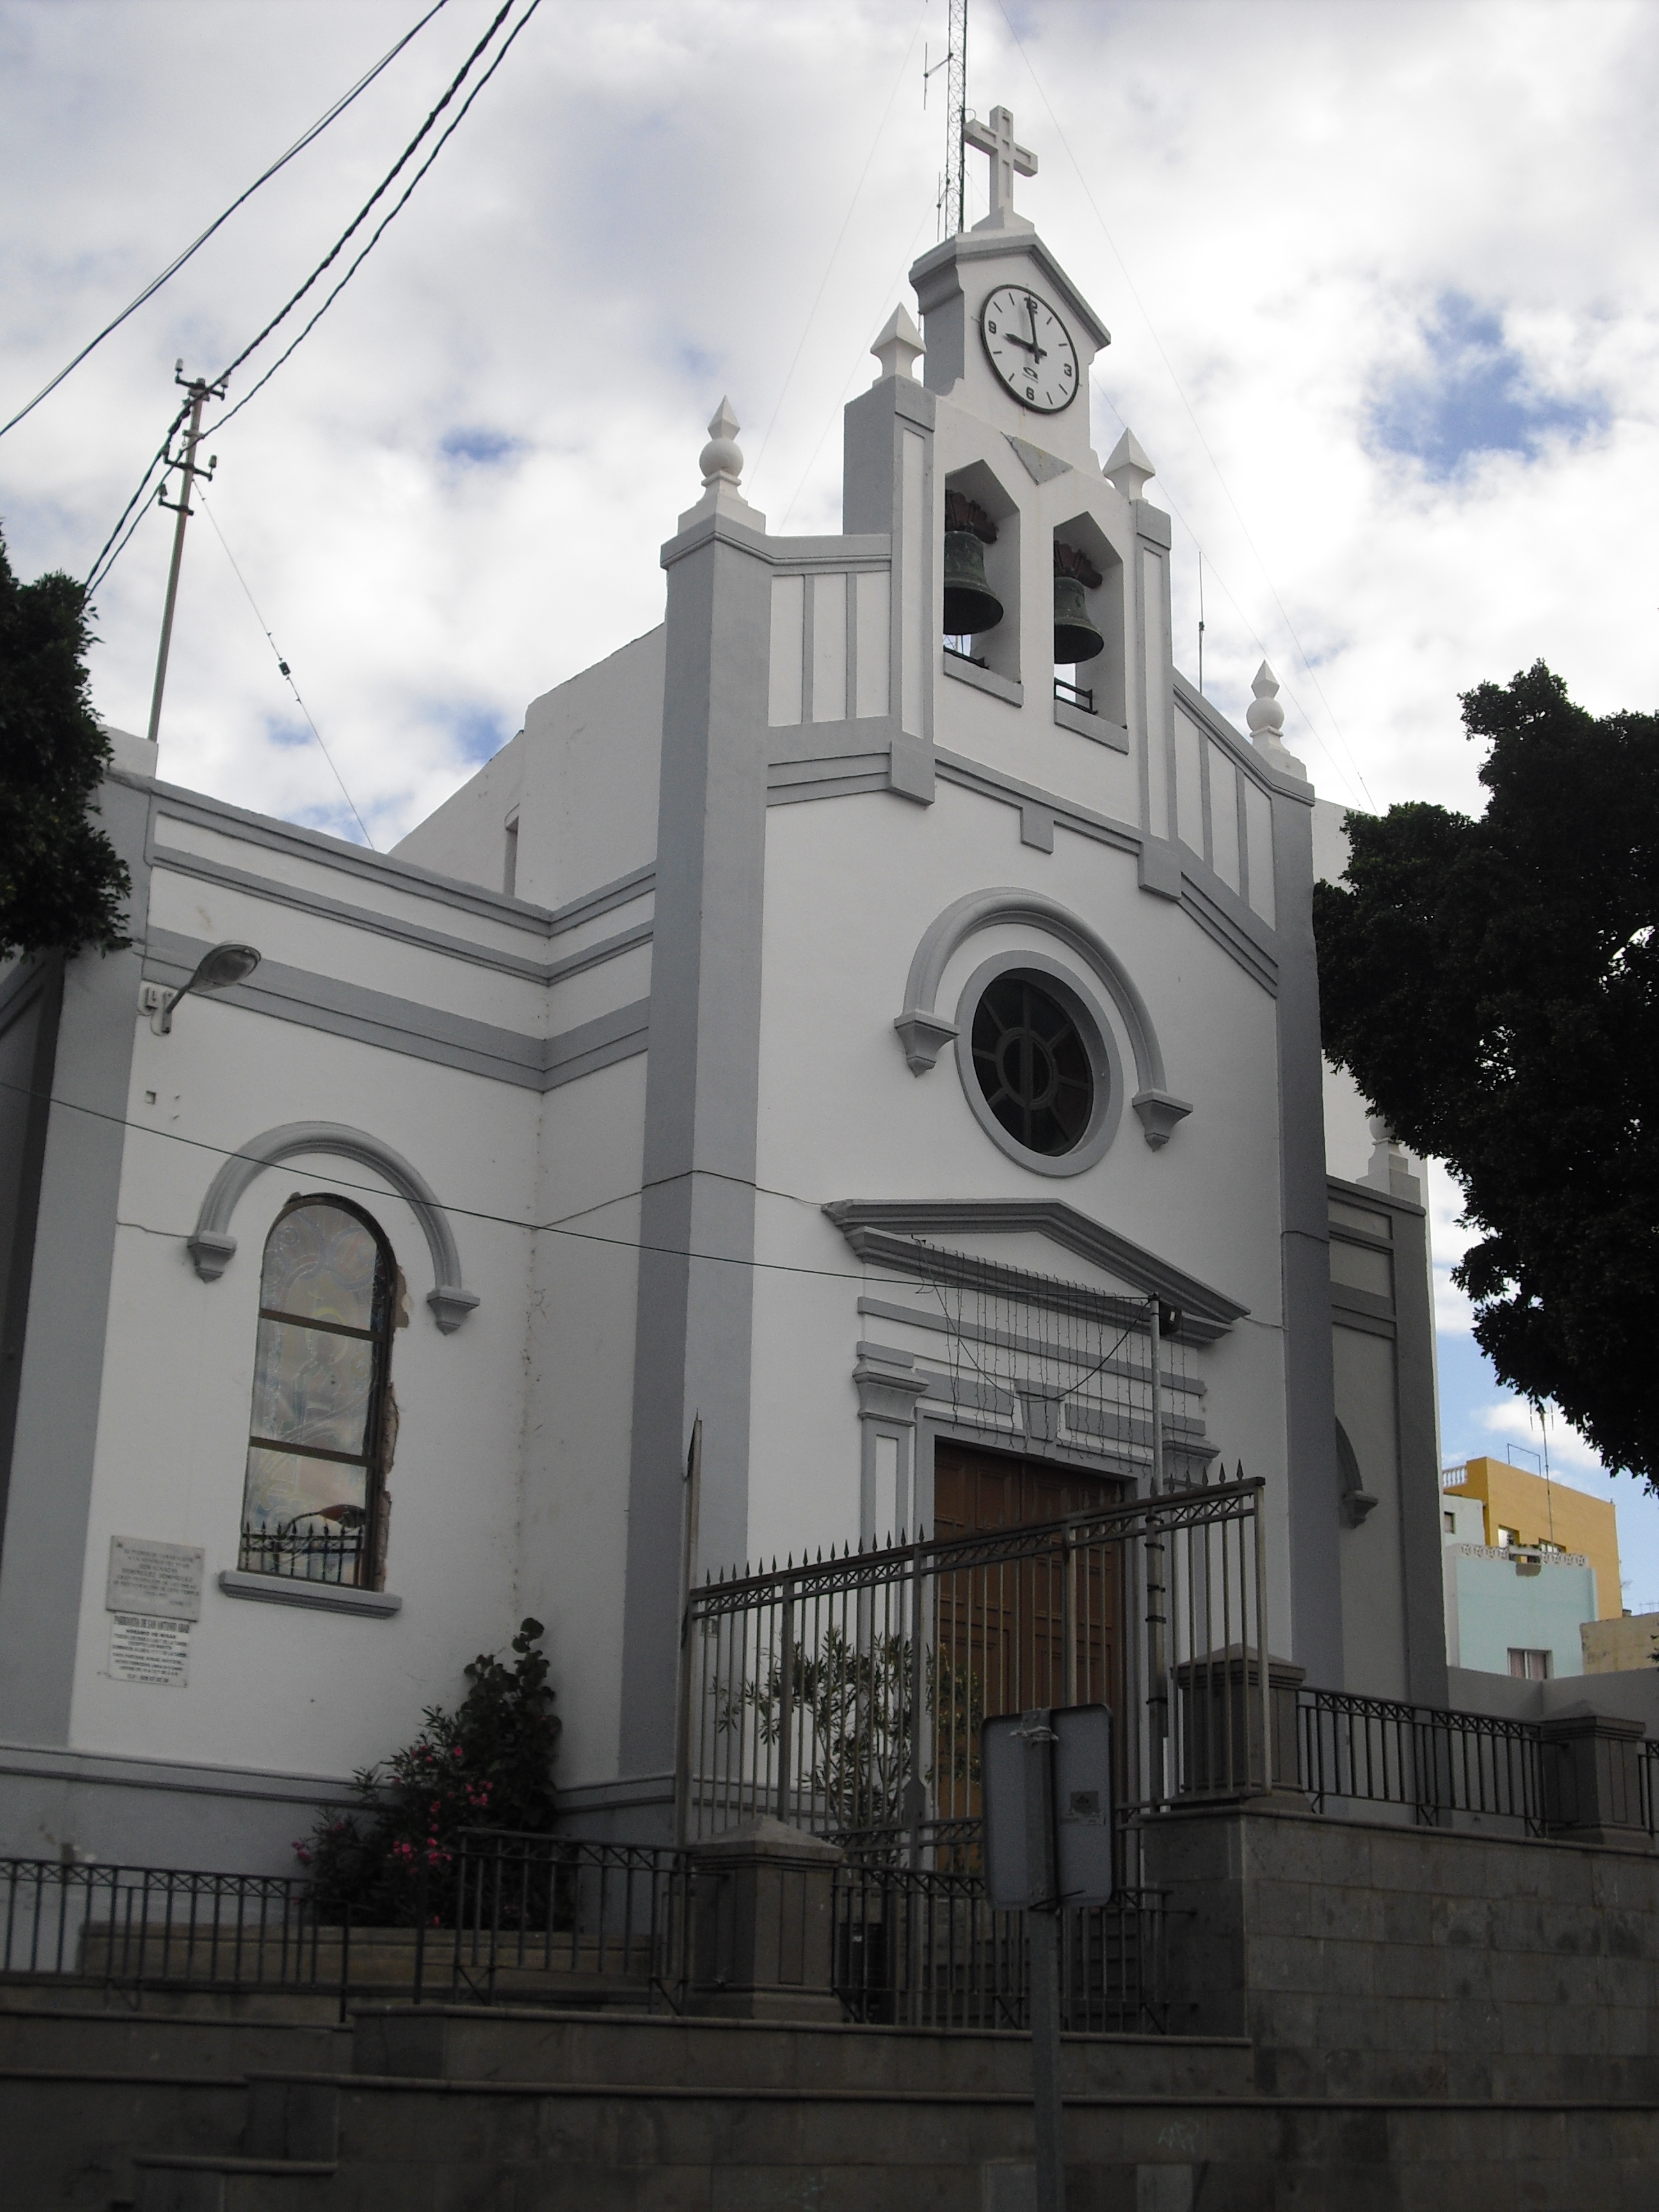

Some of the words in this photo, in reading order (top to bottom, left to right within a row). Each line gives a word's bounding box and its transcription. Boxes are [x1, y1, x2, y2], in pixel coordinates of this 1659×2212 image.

[988, 320, 997, 334] 9
[1064, 363, 1072, 378] 3
[1026, 386, 1034, 401] 6
